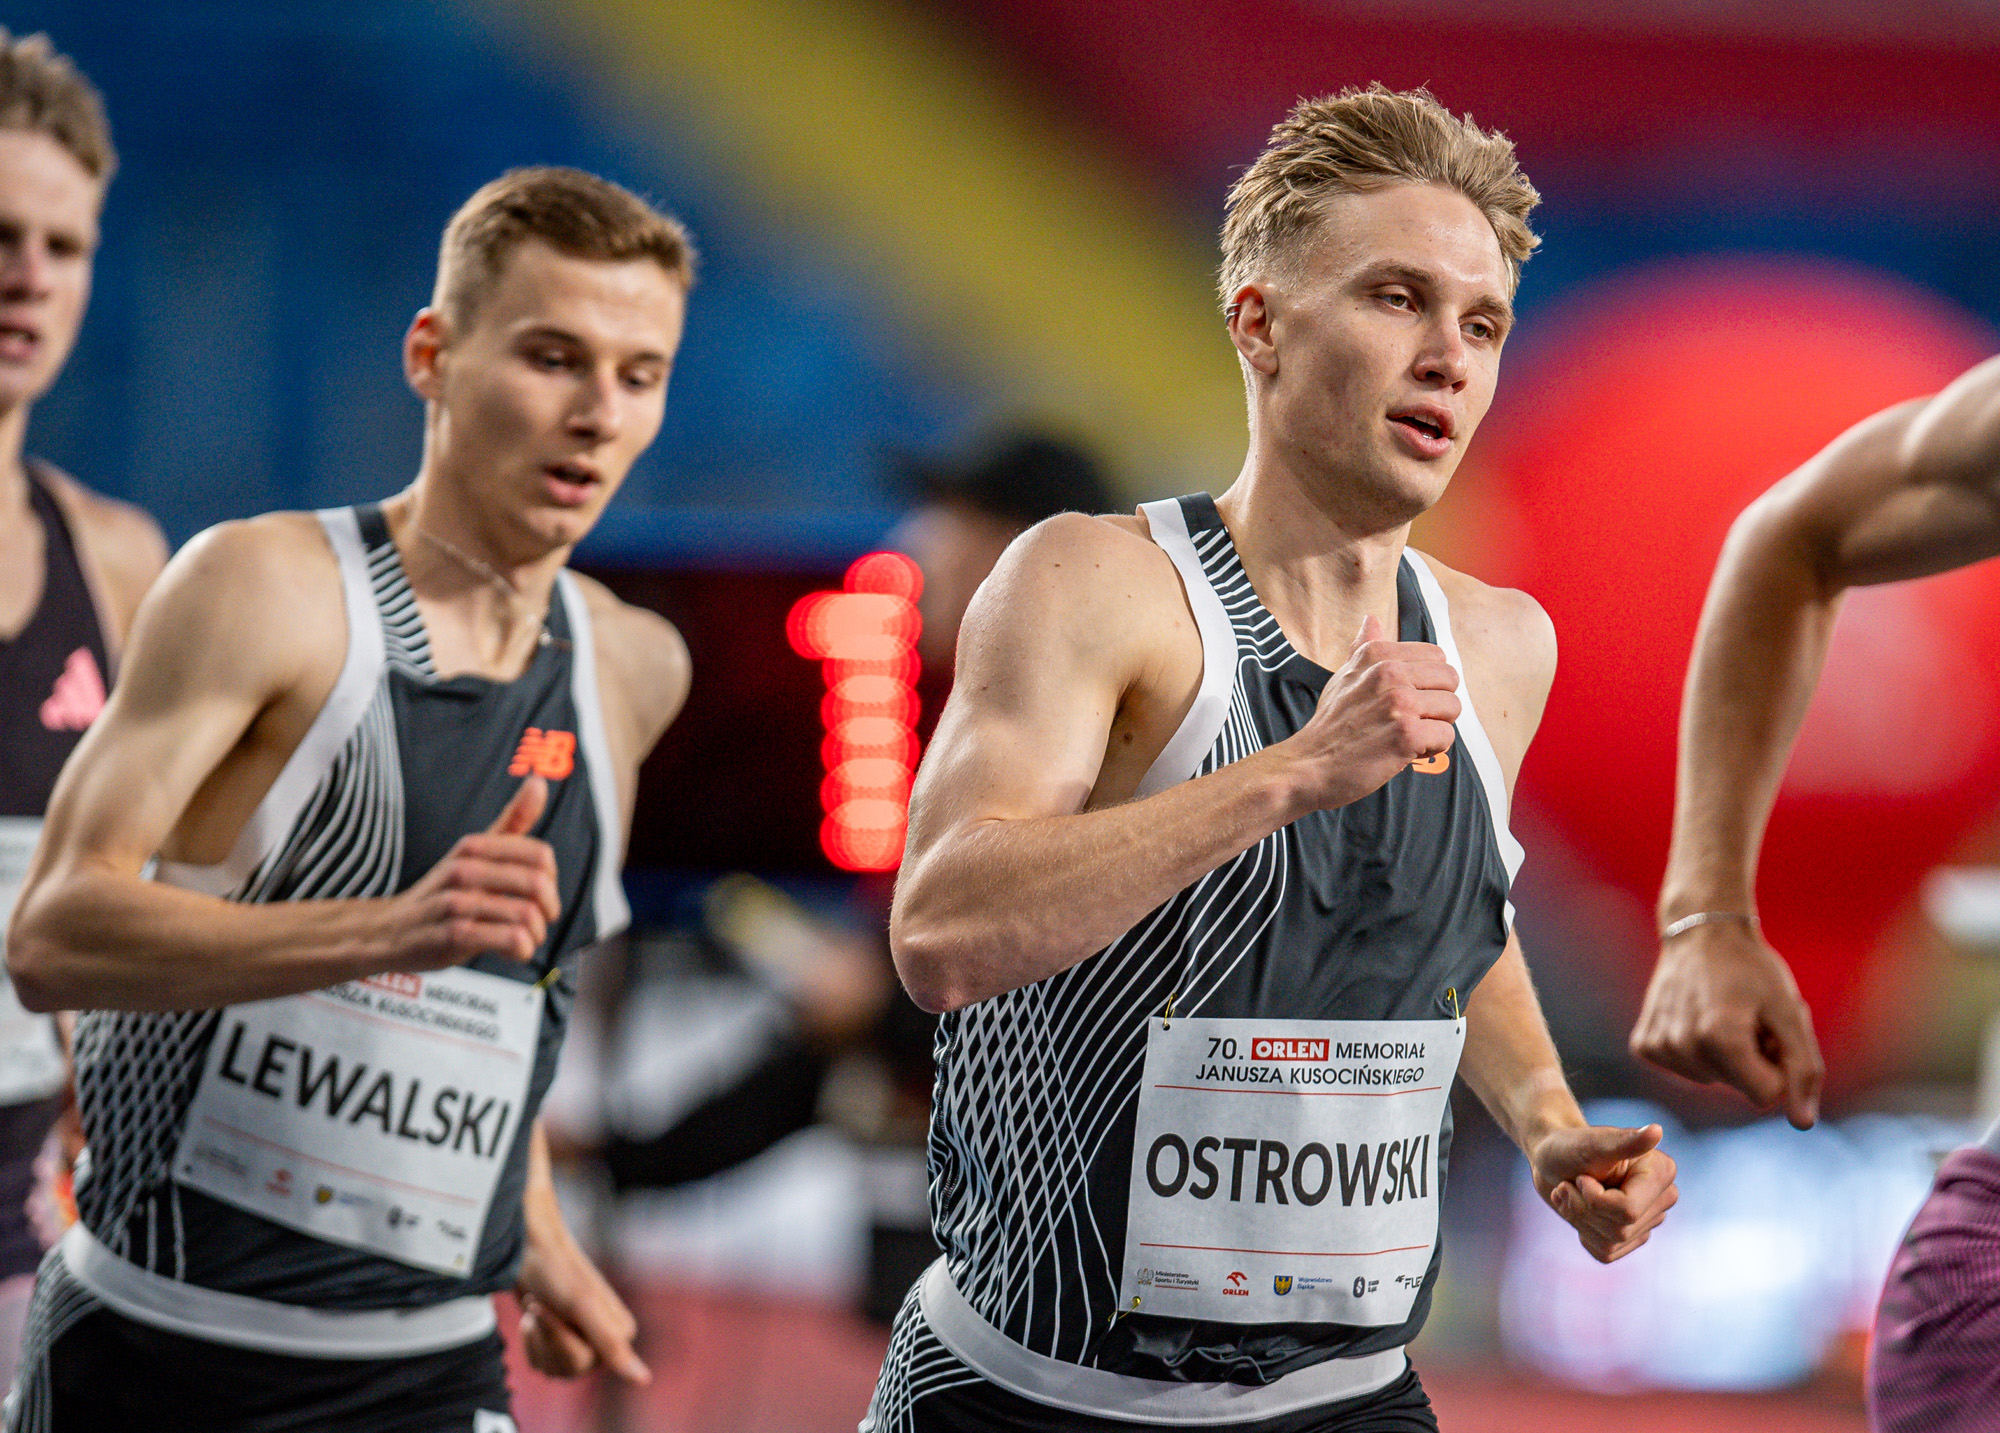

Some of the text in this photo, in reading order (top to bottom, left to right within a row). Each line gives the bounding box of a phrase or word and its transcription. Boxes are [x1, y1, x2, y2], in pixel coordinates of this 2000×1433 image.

[1207, 1037, 1426, 1060] 70. ORLEN MEMORIAŁ
[1195, 1064, 1424, 1085] JANUSZA KUSOCIŃSKIEGO
[219, 1021, 509, 1160] LEWALSKI
[1146, 1132, 1430, 1207] OSTROWSKI
[1222, 1288, 1249, 1296] ORLEN
